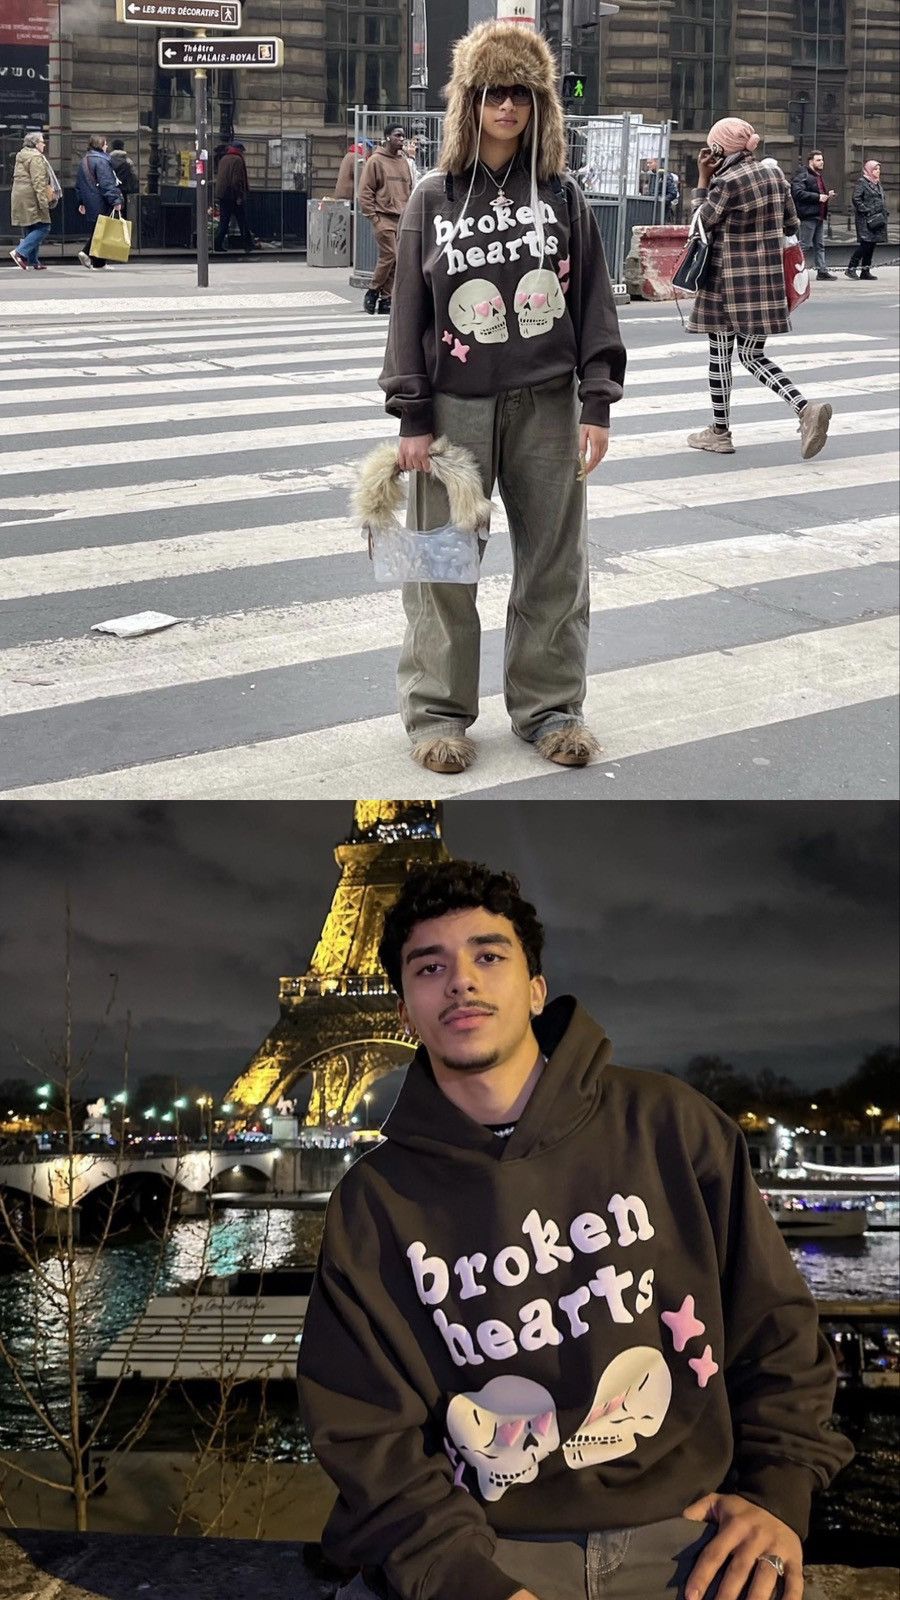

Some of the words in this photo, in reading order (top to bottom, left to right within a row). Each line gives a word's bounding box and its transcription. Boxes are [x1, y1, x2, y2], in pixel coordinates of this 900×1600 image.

[142, 5, 155, 14] LES
[157, 6, 176, 15] ARTS
[178, 6, 220, 17] DÉCORATIFS
[183, 54, 193, 62] du
[196, 54, 256, 62] PALAIS-ROYAL
[433, 200, 558, 246] broken
[446, 230, 559, 276] hearts
[406, 1193, 655, 1305] broken
[433, 1264, 655, 1367] hearts
